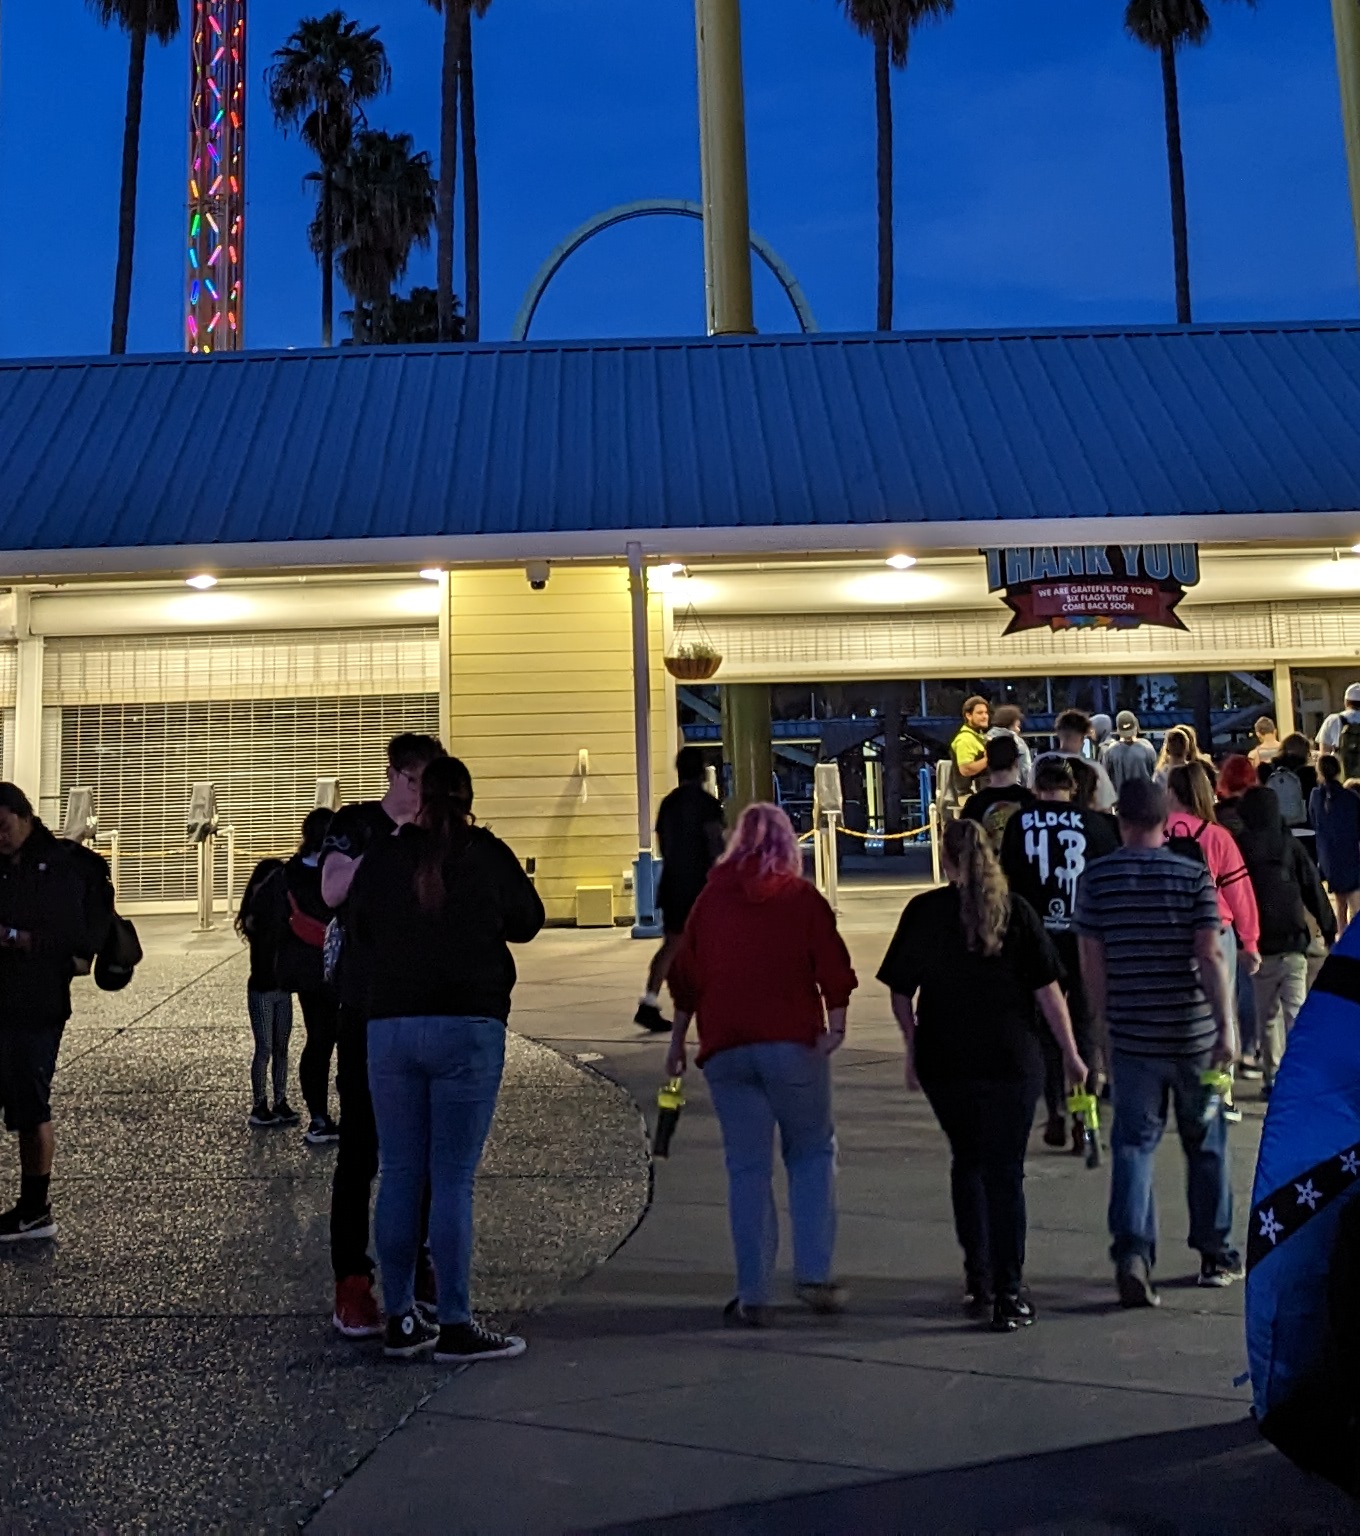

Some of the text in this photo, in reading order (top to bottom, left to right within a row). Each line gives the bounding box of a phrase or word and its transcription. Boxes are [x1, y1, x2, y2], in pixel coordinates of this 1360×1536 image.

[981, 543, 1199, 588] THANK YOU
[1038, 585, 1153, 597] WE ARE GRATEFUL FOR YOUR
[1066, 593, 1126, 603] SIX FLAGS VISIT
[1062, 602, 1134, 611] COME BACK SOON
[1022, 810, 1084, 830] BLOCK
